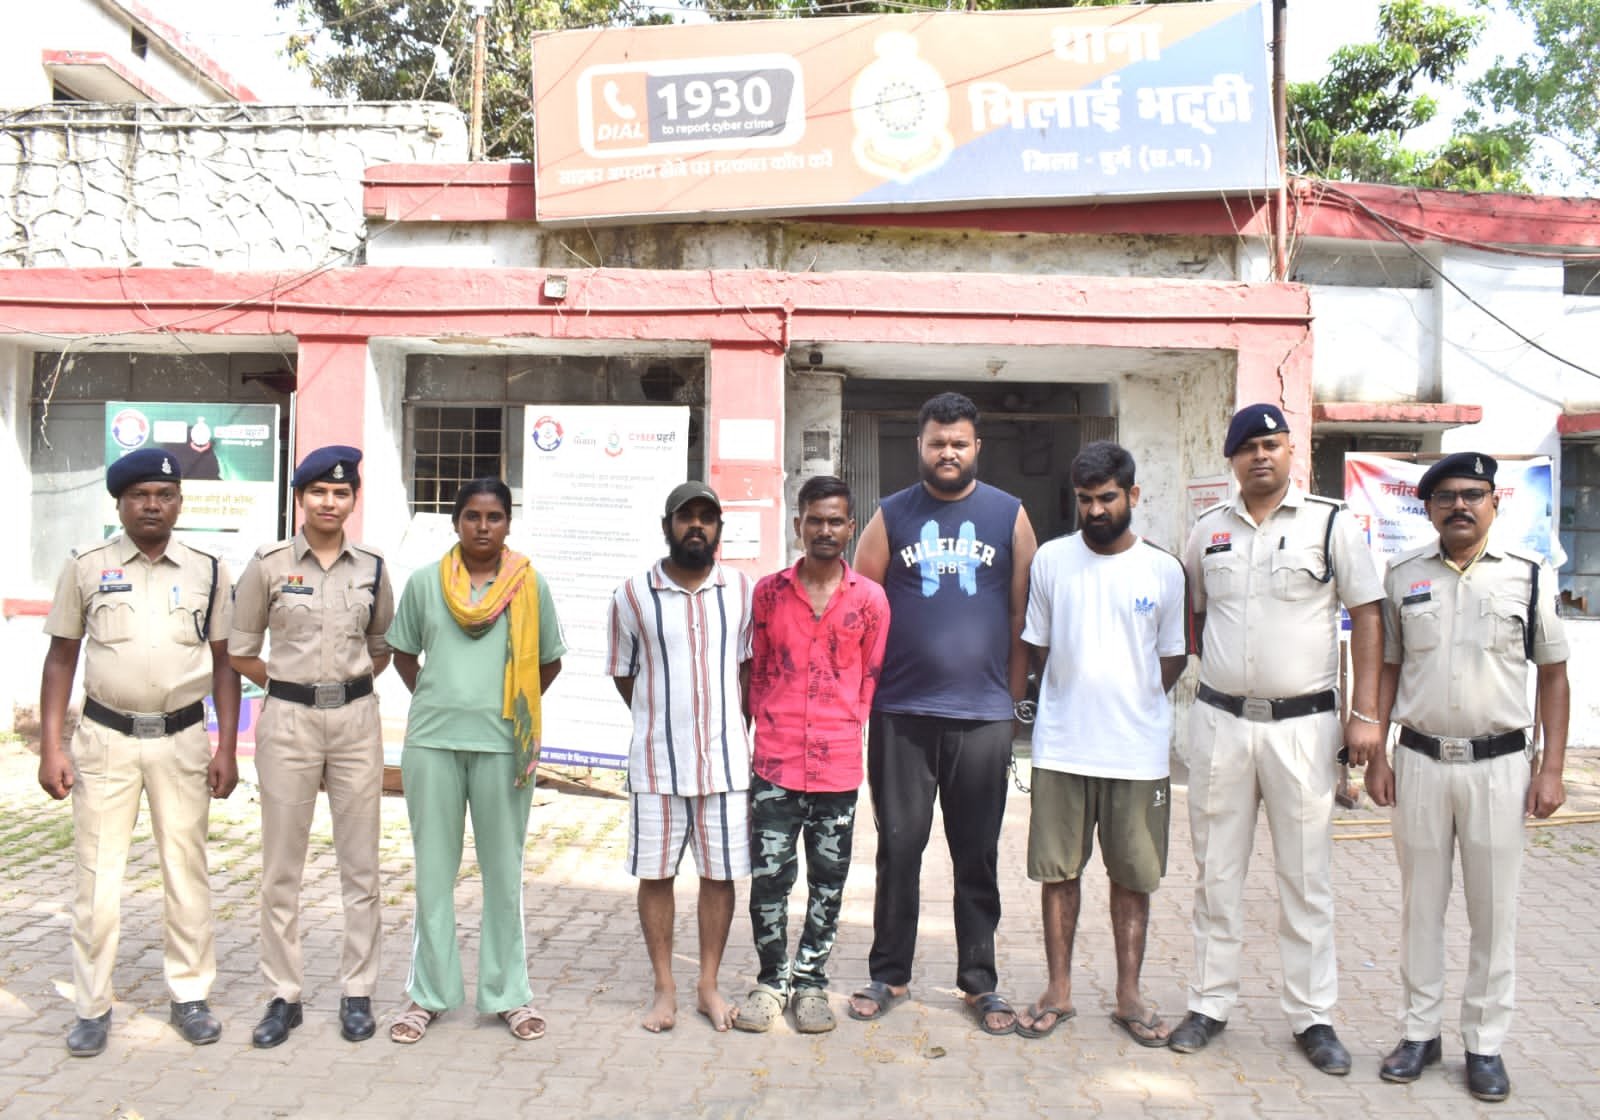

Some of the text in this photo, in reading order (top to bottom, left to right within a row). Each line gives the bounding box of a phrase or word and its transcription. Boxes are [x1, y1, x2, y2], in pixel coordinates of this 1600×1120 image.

[1050, 24, 1163, 63] थाना
[658, 77, 773, 121] 1930
[967, 75, 1122, 133] भिलाई
[598, 123, 643, 141] DIAL
[662, 118, 774, 136] to report cyber crime
[629, 431, 656, 441] CYBER
[900, 537, 996, 568] HILFIGER
